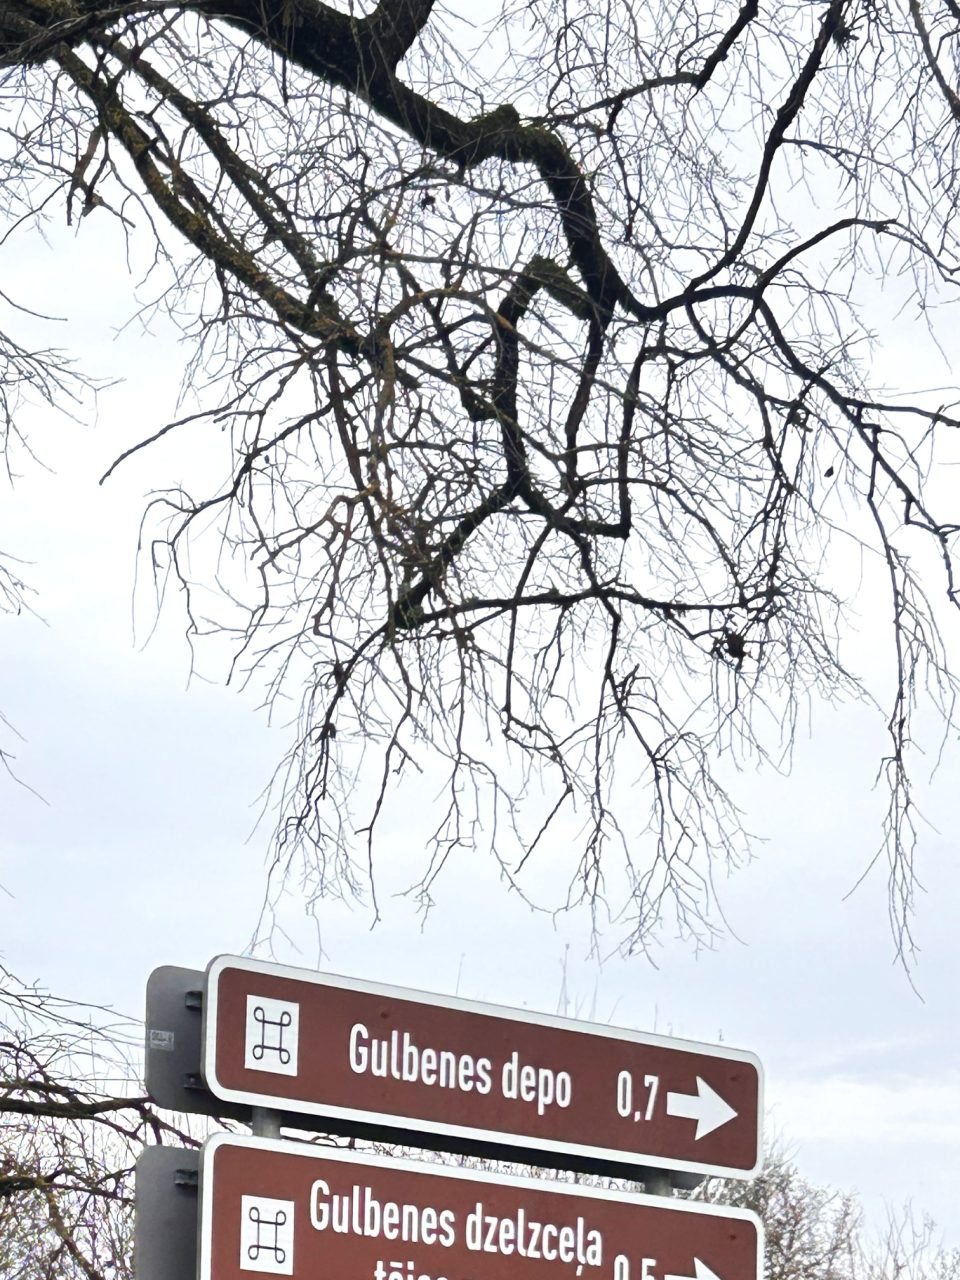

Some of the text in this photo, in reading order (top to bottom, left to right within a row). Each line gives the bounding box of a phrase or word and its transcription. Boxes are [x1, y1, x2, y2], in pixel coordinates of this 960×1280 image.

[348, 1022, 659, 1122] Gulbenes depo 0,7
[309, 1179, 603, 1276] Gulbenes dzelzceļa
